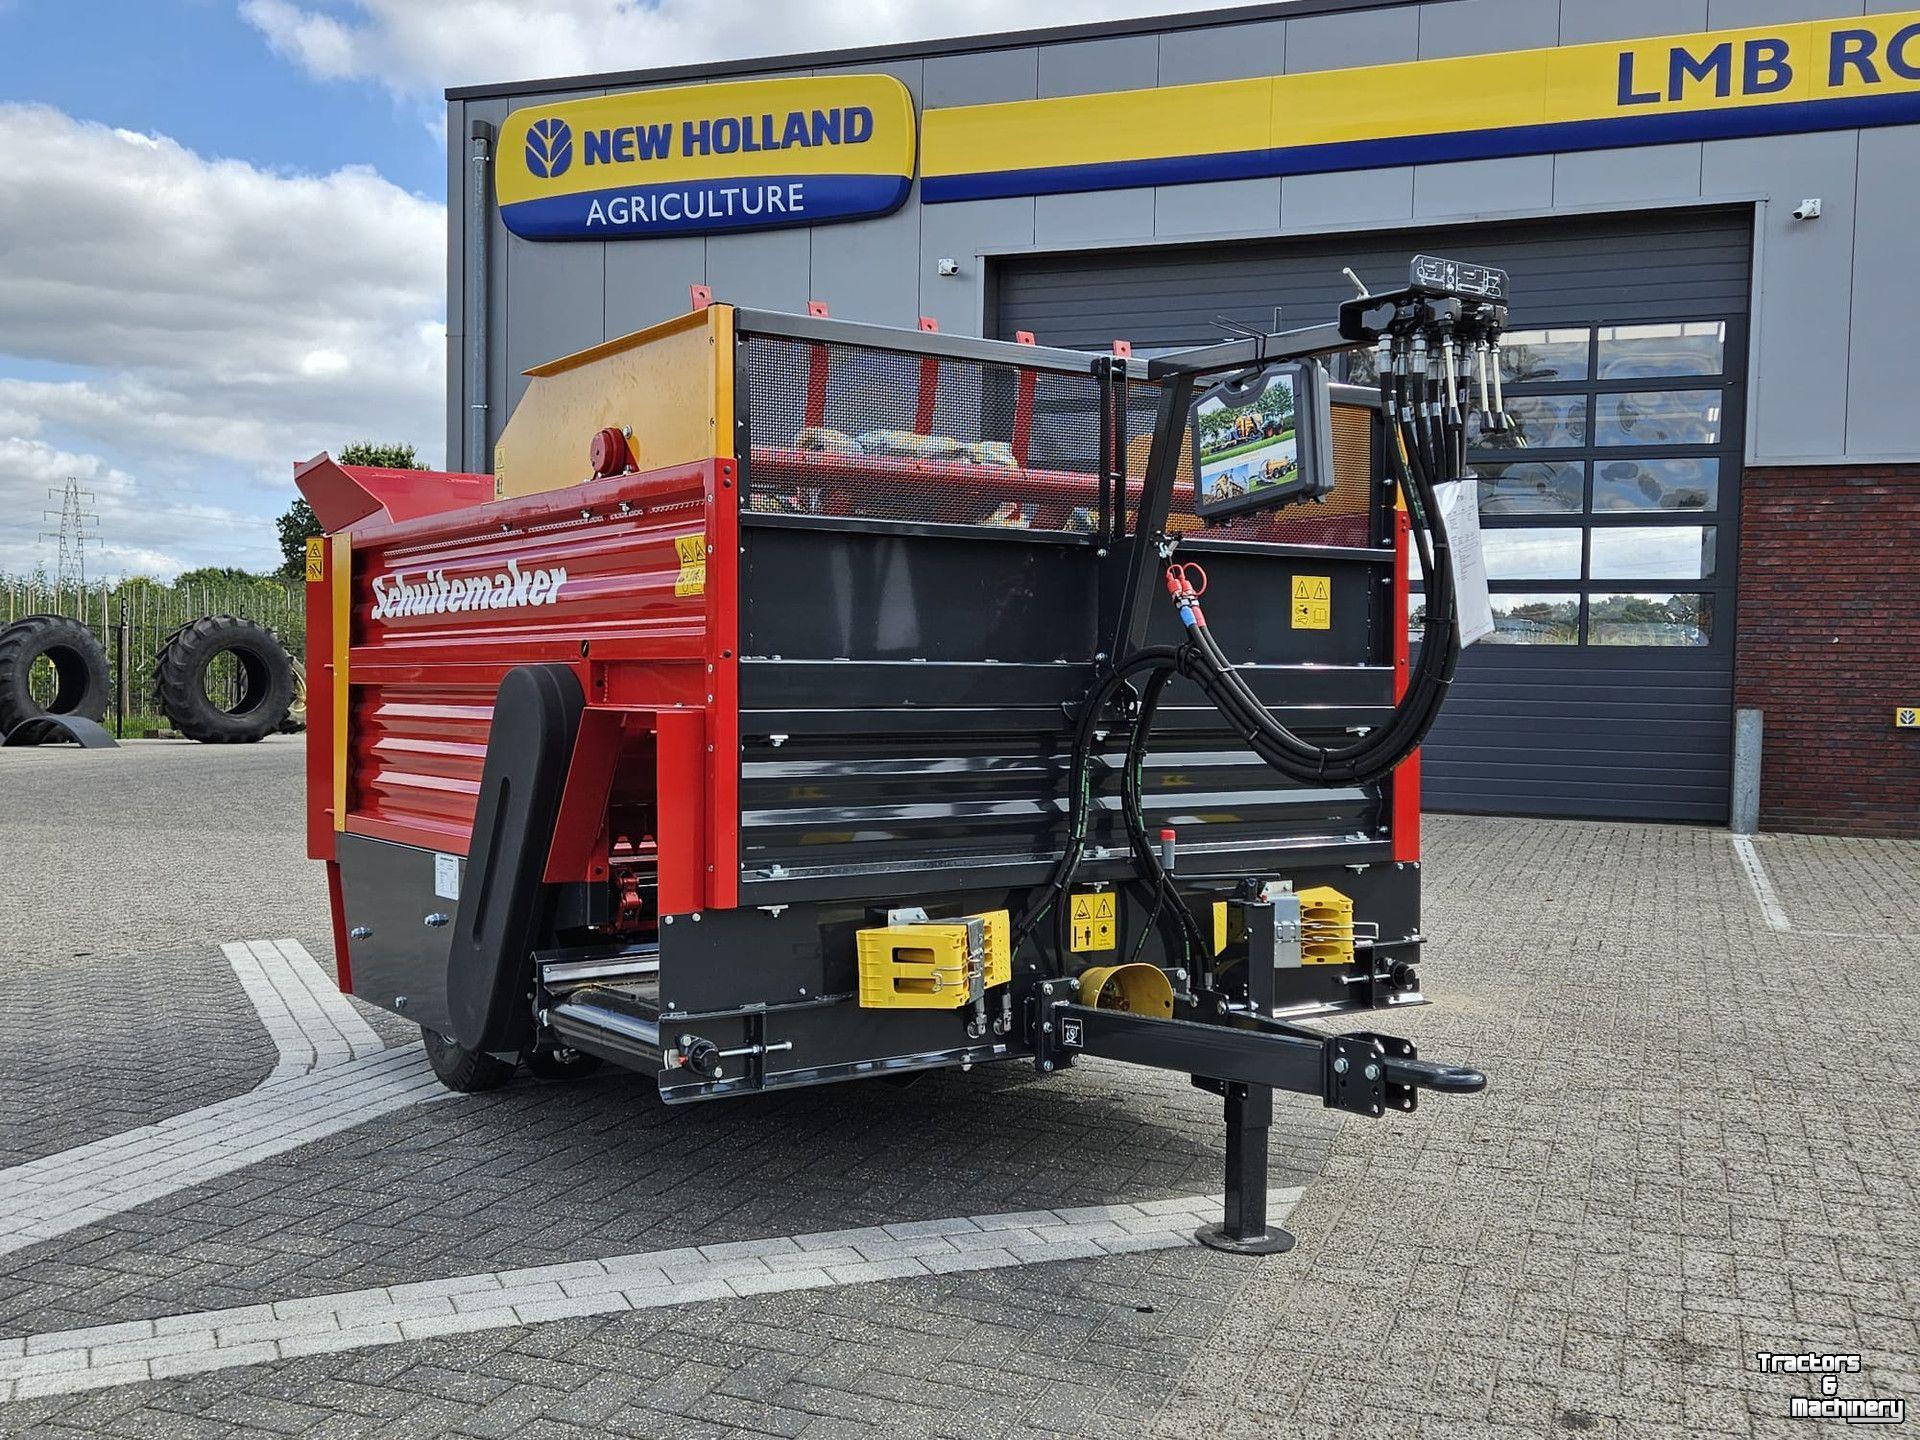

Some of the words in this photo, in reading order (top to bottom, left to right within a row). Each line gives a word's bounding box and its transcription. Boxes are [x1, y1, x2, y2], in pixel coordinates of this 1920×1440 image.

[1617, 38, 1793, 106] LMB
[584, 123, 672, 166] NEW
[683, 106, 873, 157] HOLLAND
[586, 184, 804, 226] AGRICULTURE
[371, 558, 567, 620] Schuitemaker
